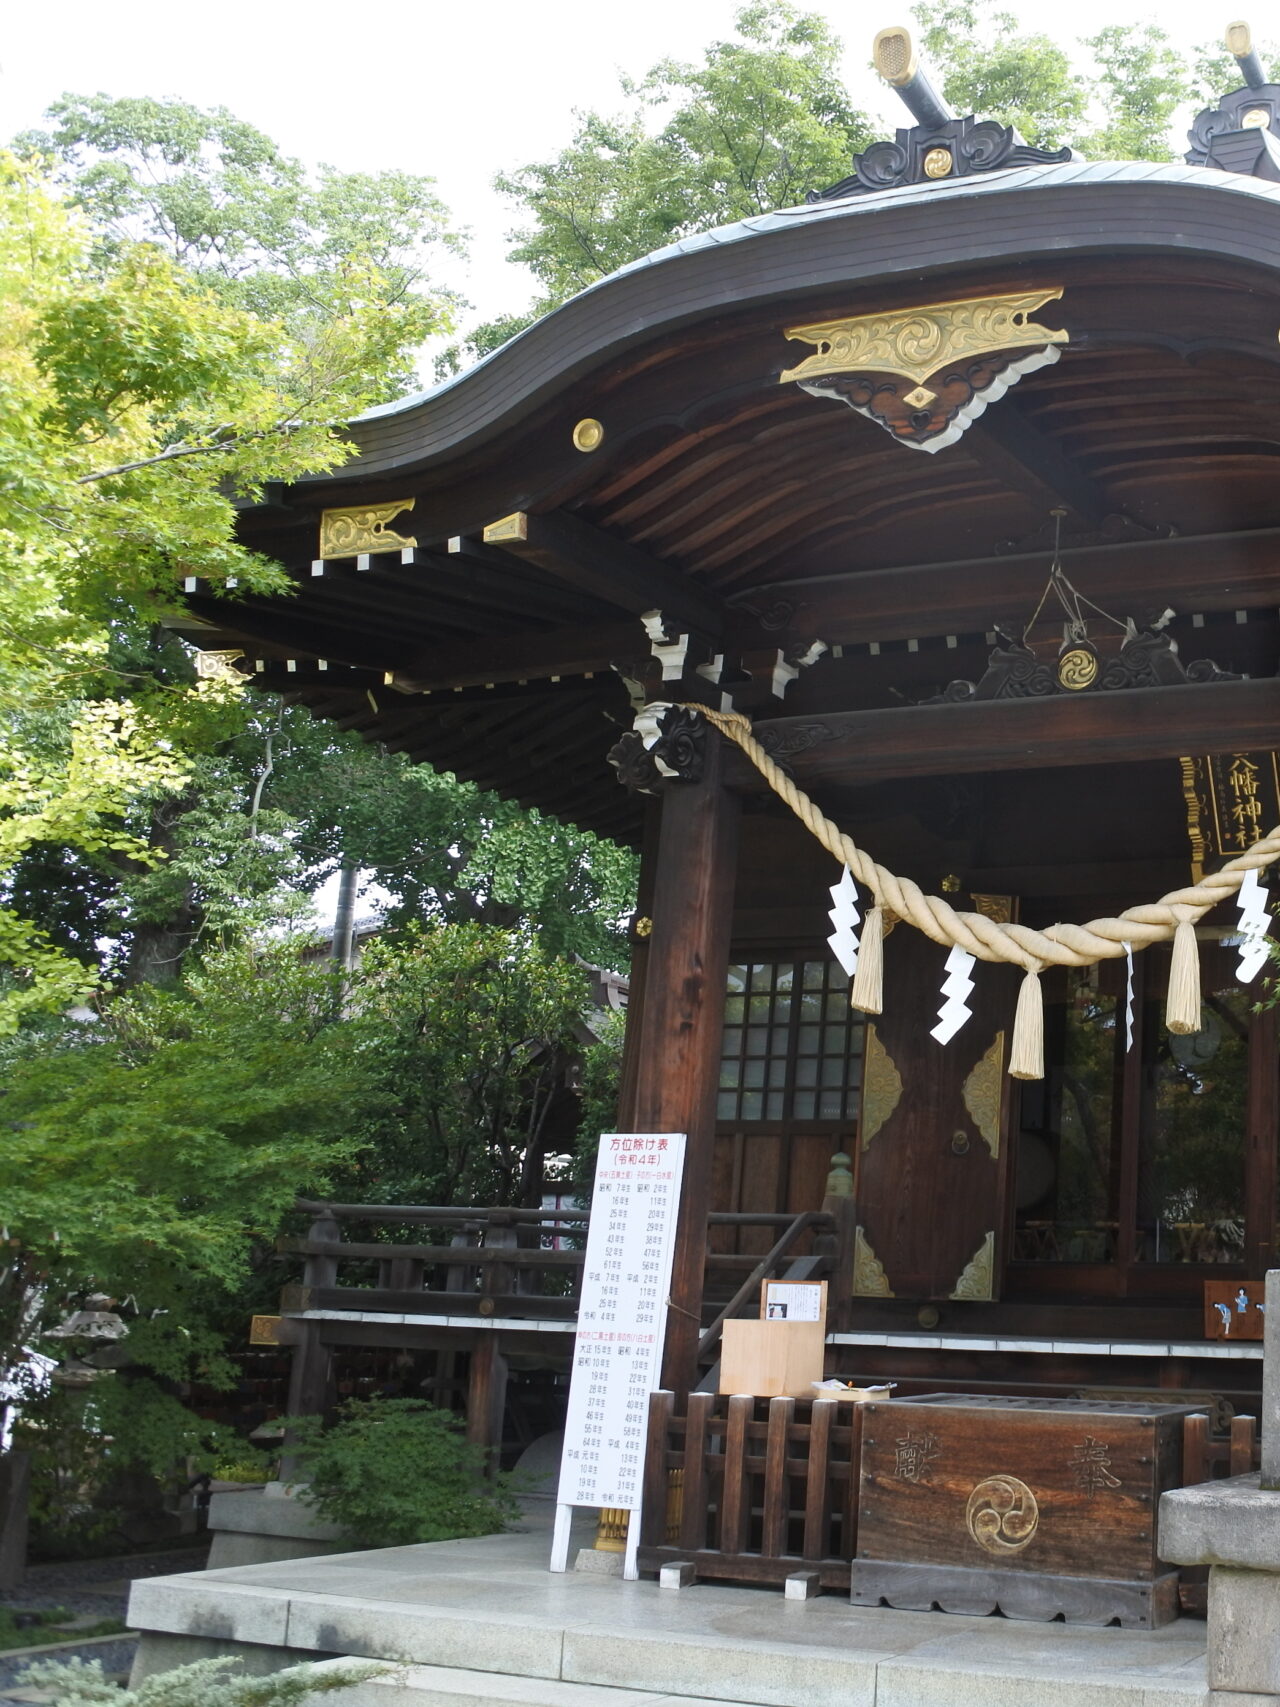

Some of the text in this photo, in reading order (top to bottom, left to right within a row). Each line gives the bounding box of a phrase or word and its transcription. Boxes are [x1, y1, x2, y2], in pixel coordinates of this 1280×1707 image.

[1230, 753, 1262, 848] 八幡神社
[610, 1138, 668, 1151] 方位除け表
